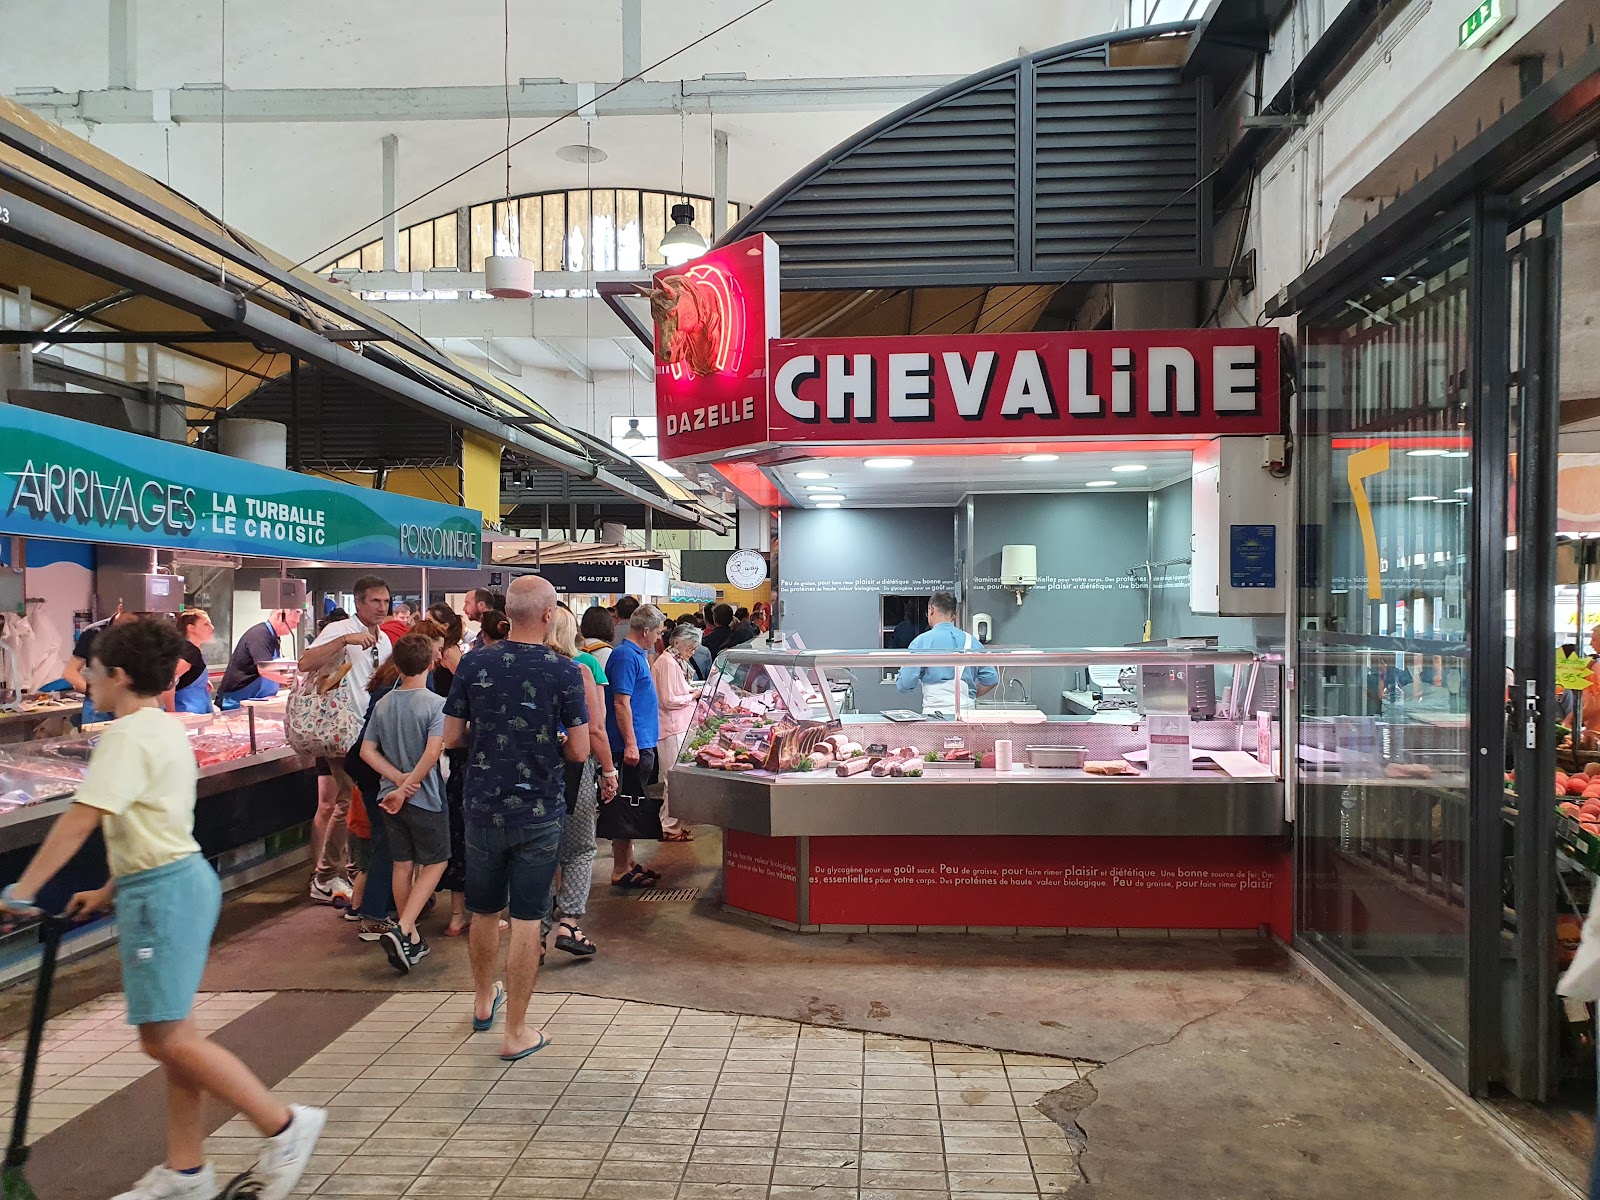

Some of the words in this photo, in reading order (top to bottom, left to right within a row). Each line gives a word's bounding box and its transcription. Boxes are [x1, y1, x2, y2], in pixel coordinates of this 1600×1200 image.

[666, 396, 754, 436] DAZELLE
[3, 459, 196, 530] ARRIVAGES
[213, 492, 237, 514] LA
[246, 498, 325, 527] TURBALLE
[213, 514, 236, 535] LE
[244, 519, 325, 545] CROISIC
[400, 523, 476, 559] POISSONNERIE
[855, 577, 875, 586] plaisir
[1048, 582, 1072, 591] plaisir
[809, 876, 822, 884] es,
[823, 874, 873, 883] essentielles
[893, 876, 914, 884] votre
[955, 876, 997, 887] protéines
[1010, 877, 1032, 885] haute
[1036, 878, 1061, 886] valeur
[1113, 876, 1133, 887] Peu
[1146, 880, 1173, 889] graisse,
[1176, 881, 1199, 889] pour
[1200, 880, 1216, 888] faire
[1219, 880, 1237, 888] rimer
[1240, 877, 1273, 891] plaisir
[894, 864, 915, 875] goût
[940, 864, 959, 874] Peu
[972, 867, 999, 876] graisse,
[1002, 868, 1023, 877] pour
[1065, 864, 1098, 878] plaisir
[1178, 867, 1208, 877] bonne
